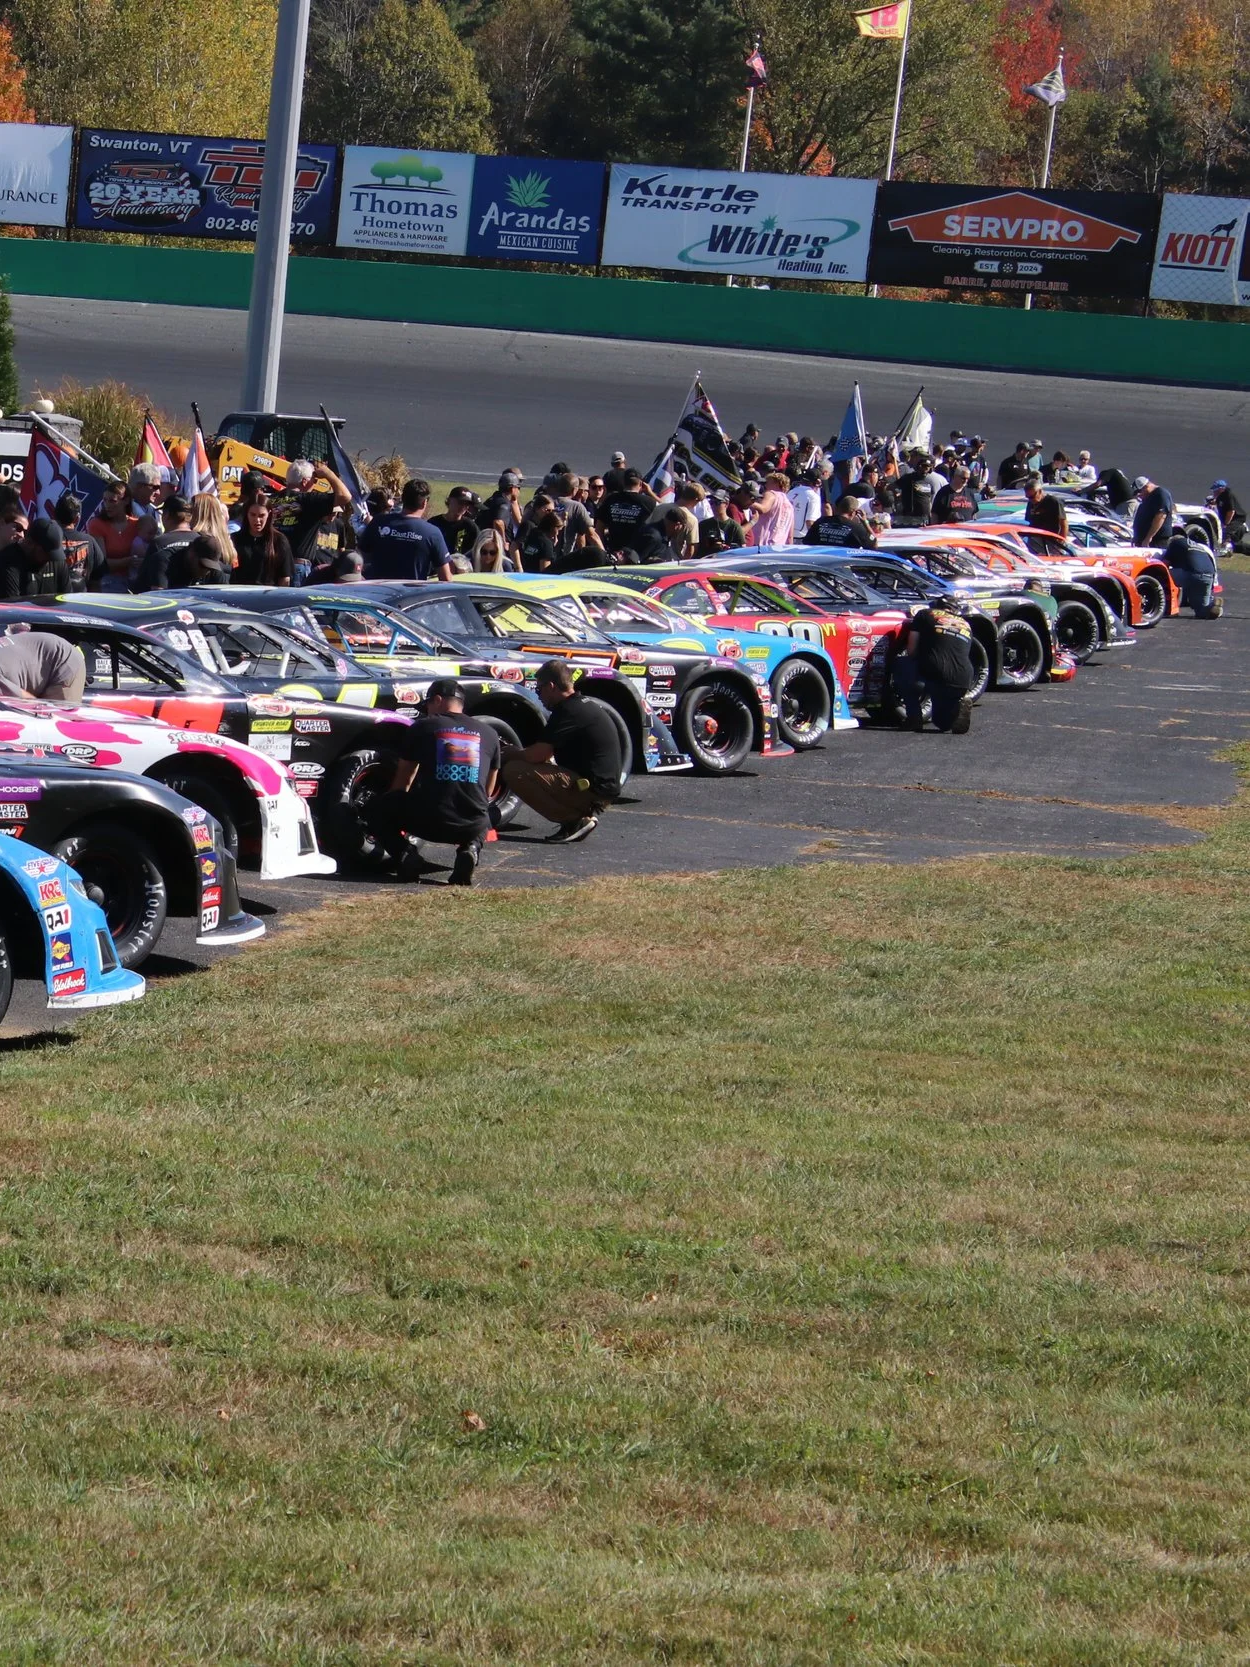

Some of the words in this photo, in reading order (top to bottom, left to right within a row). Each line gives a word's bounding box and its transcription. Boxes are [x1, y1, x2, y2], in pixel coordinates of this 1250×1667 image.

[89, 135, 163, 155] Swanton,
[170, 140, 193, 154] VT
[88, 182, 121, 199] 20
[125, 184, 200, 205] YEAR
[623, 173, 760, 202] Kurrle
[94, 198, 195, 222] Anniversary
[350, 191, 458, 219] Thomas
[620, 196, 756, 215] TRANSPORT
[362, 215, 445, 233] Hometown
[478, 201, 591, 236] Arandas
[942, 213, 1084, 243] SERVPRO
[353, 229, 399, 239] APPLIANCES
[406, 233, 448, 243] HARDWARE
[499, 234, 539, 248] MEXICAN
[541, 237, 578, 250] CUISINE
[707, 222, 830, 259] White's
[1161, 232, 1236, 267] KIOTI
[778, 258, 825, 275] Heating,
[827, 260, 850, 275] Inc.
[978, 262, 996, 273] EST.
[1018, 263, 1039, 274] 2024
[222, 466, 244, 483] CAT
[391, 529, 423, 541] EastRise
[67, 747, 92, 756] DRP
[294, 765, 320, 774] DRP
[40, 880, 62, 900] KRC
[46, 908, 70, 930] QA1
[128, 881, 165, 954] Hoosier
